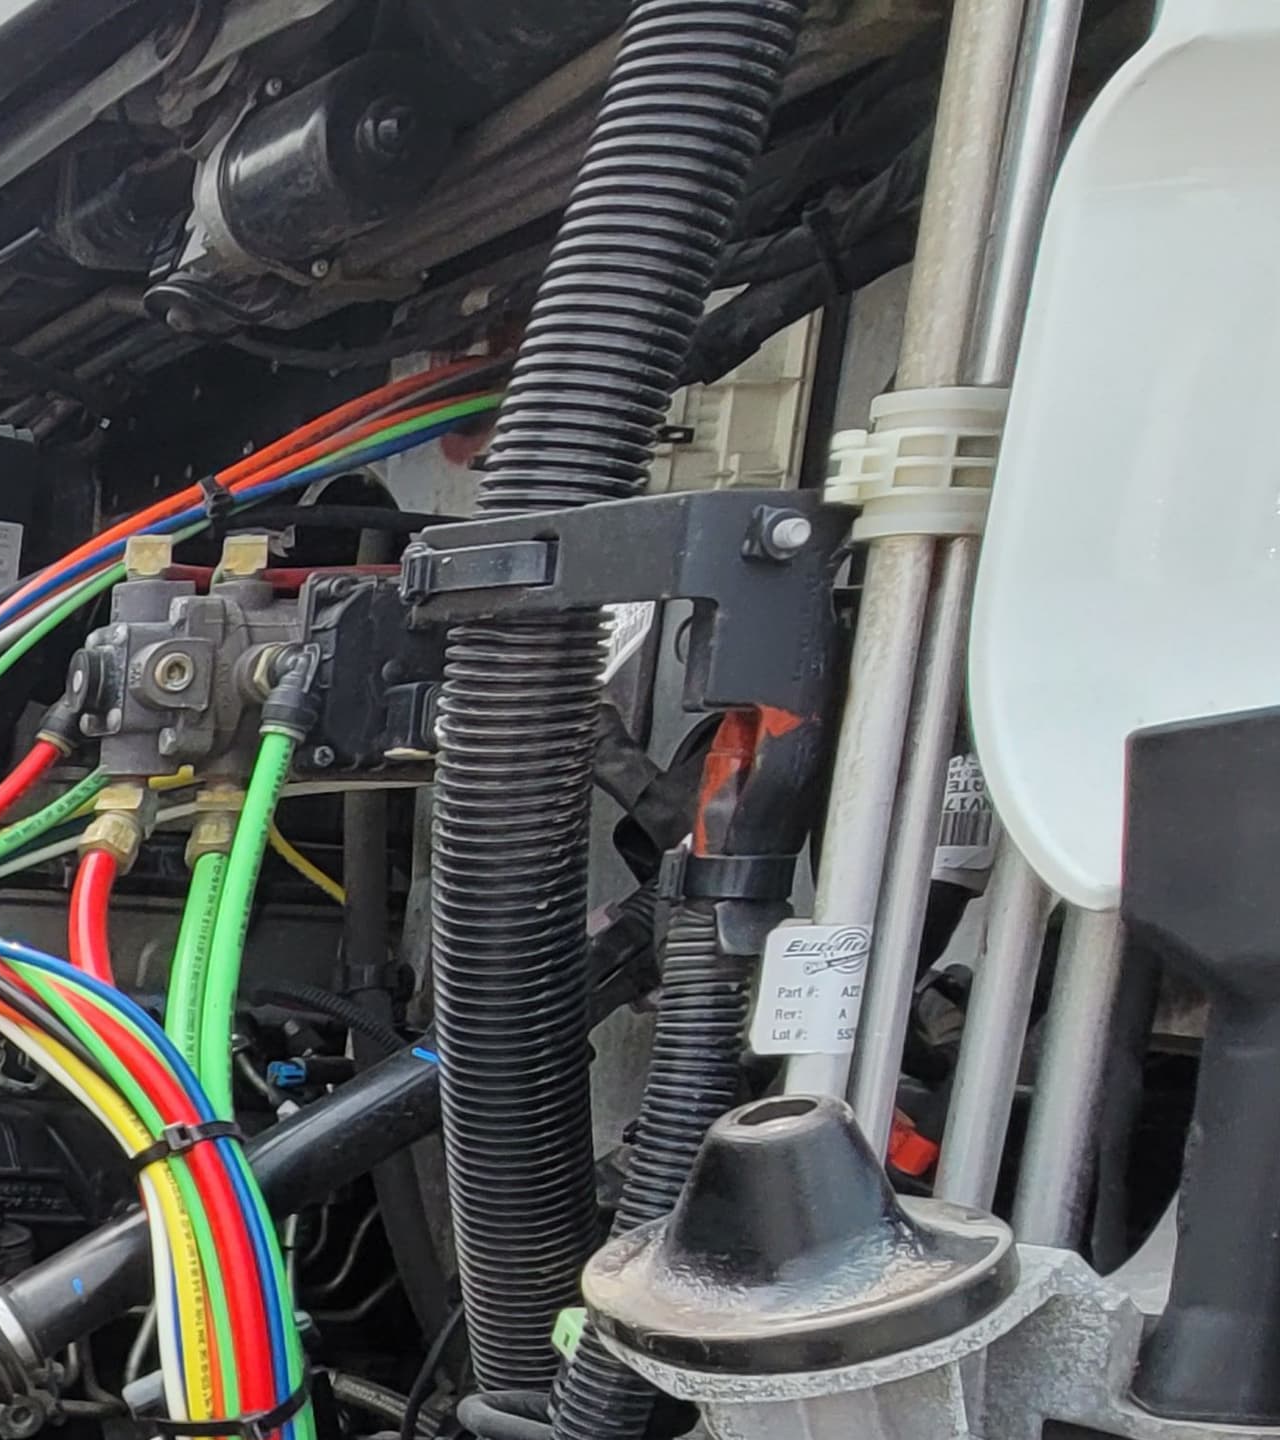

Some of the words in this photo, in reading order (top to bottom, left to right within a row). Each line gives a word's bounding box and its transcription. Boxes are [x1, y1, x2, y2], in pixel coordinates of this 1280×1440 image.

[777, 986, 803, 999] Part
[774, 1008, 803, 1020] Rev:
[838, 1008, 848, 1020] A
[772, 1028, 792, 1041] Lot
